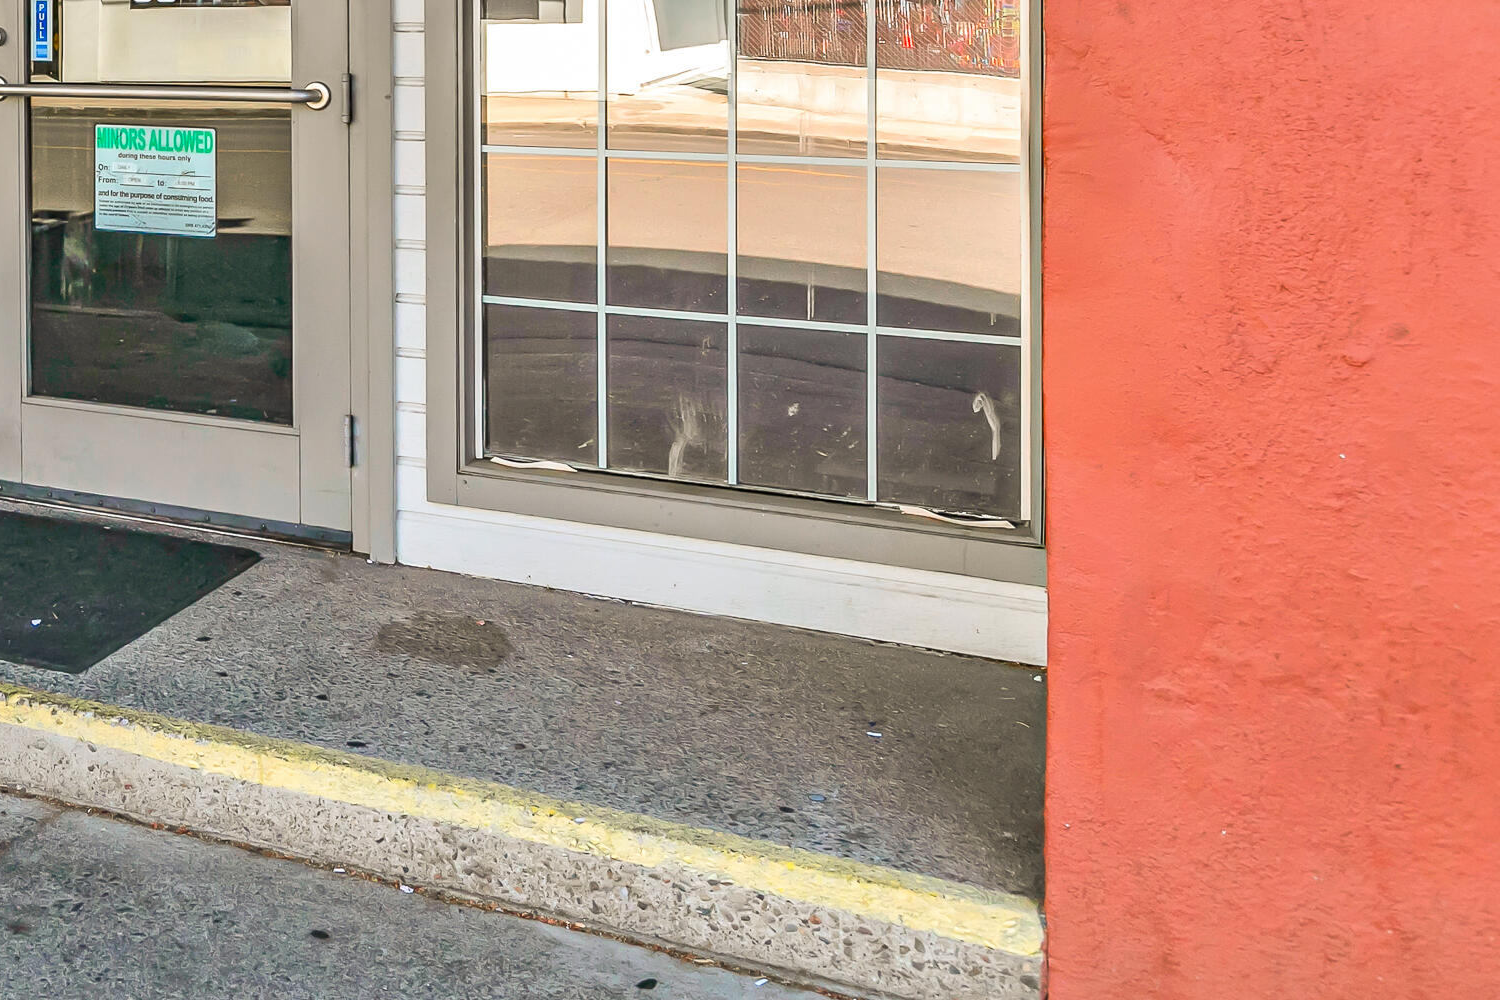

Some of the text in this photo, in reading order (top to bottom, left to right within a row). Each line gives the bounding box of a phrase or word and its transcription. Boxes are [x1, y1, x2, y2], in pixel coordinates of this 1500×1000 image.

[97, 127, 213, 153] MINORS ALLOWED
[118, 152, 138, 160] during
[130, 192, 155, 200] purpose
[163, 194, 197, 203] consuming
